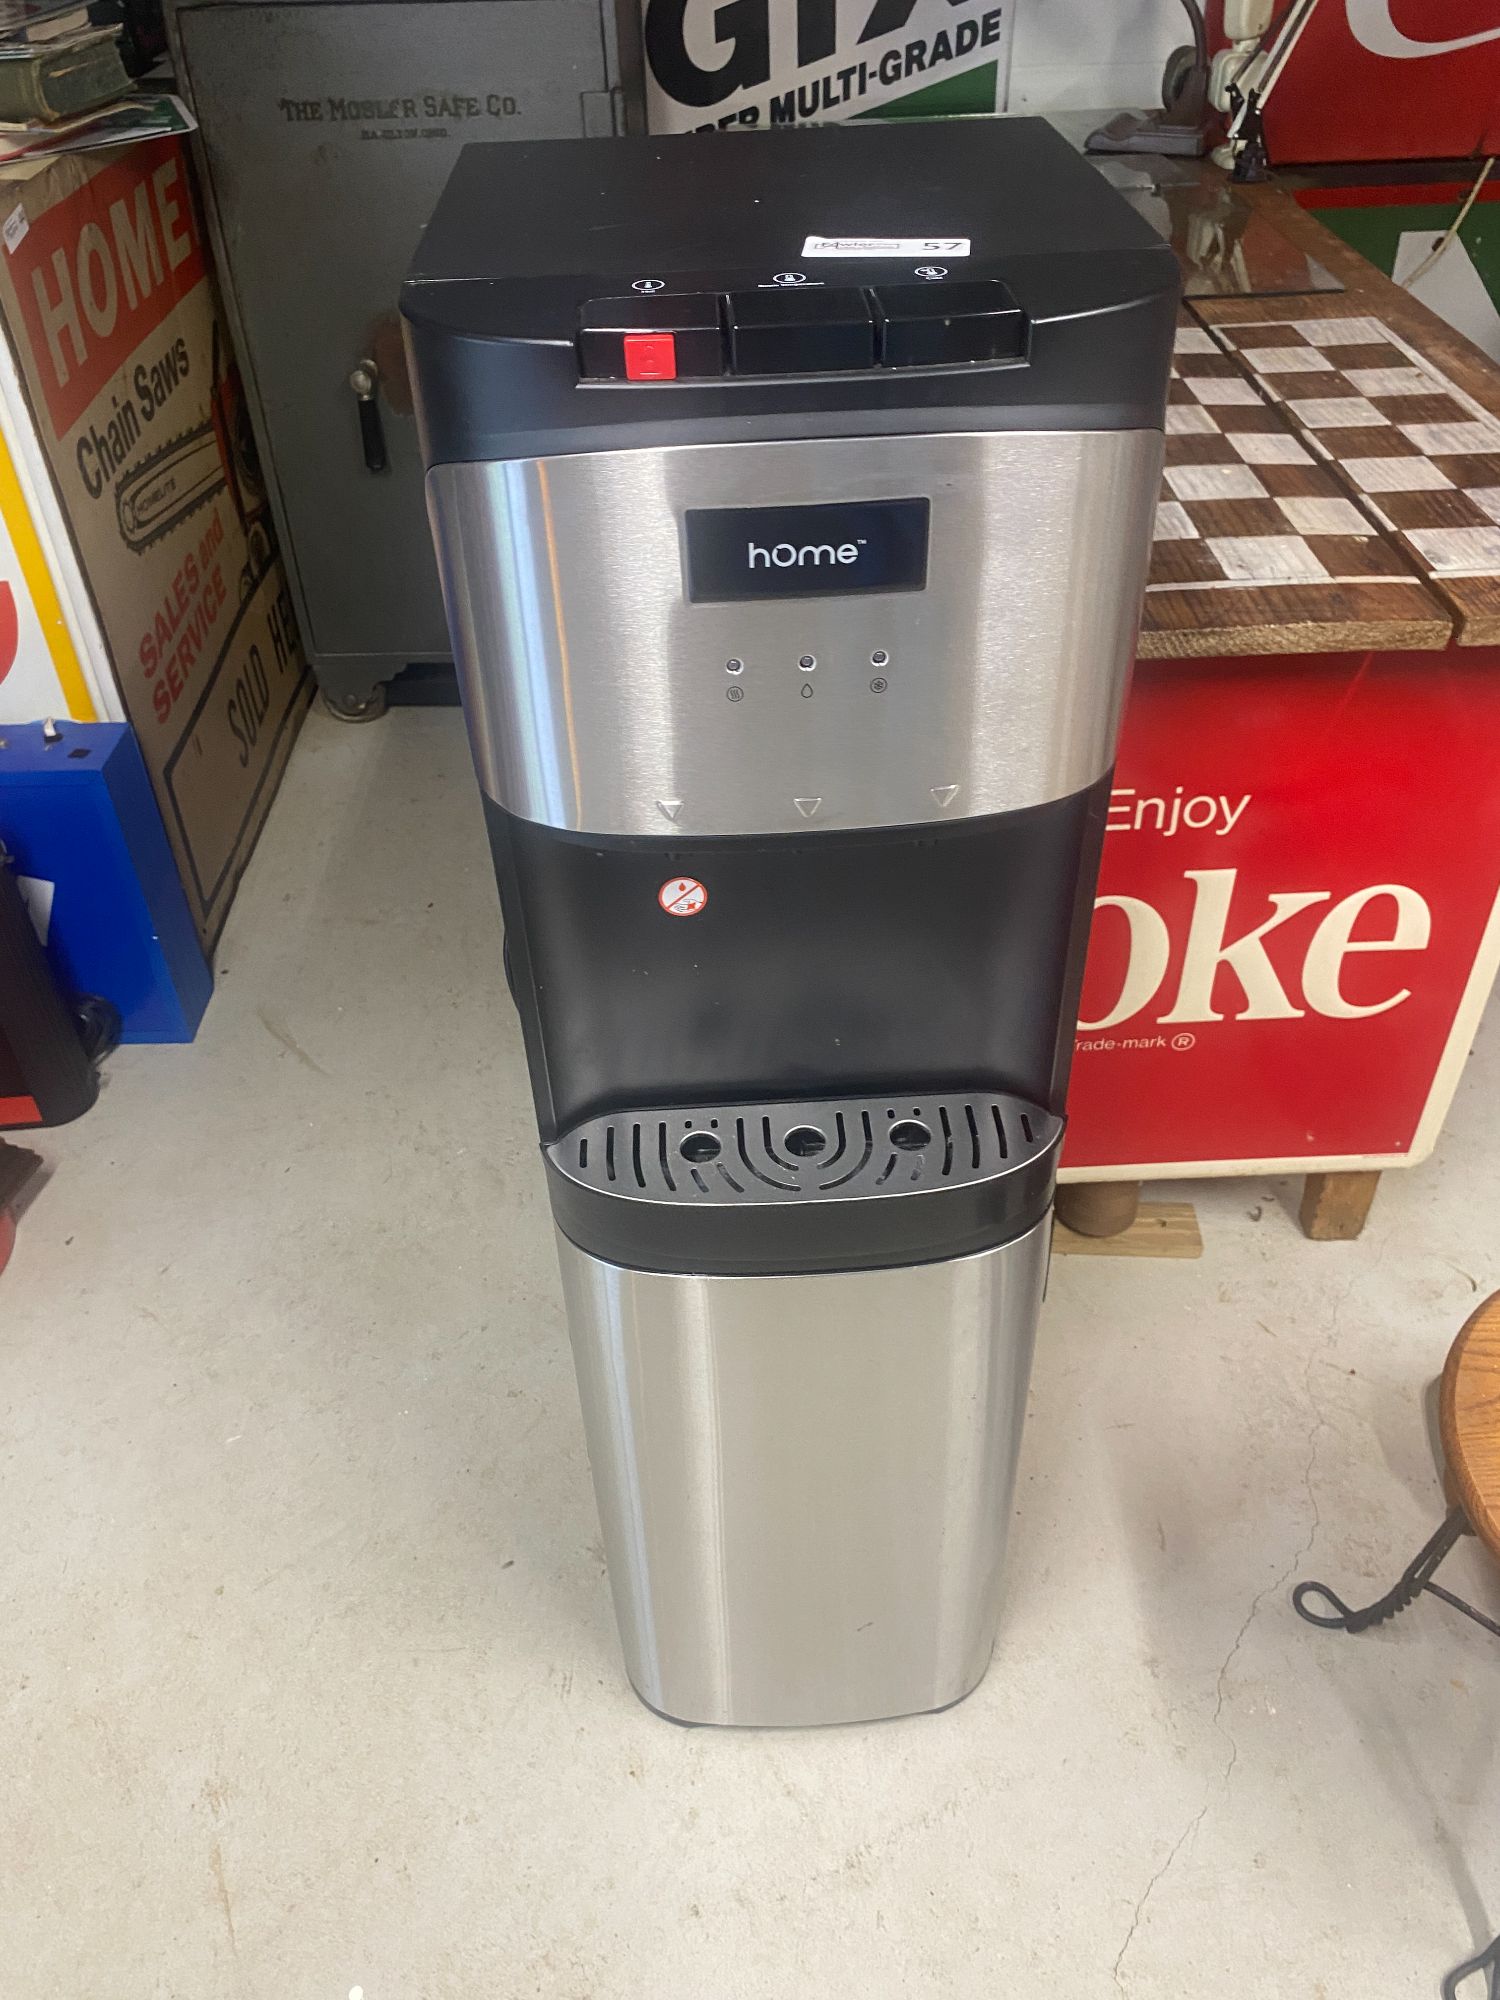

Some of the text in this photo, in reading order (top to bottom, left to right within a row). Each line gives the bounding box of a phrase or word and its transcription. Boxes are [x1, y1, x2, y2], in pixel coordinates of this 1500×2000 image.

[280, 97, 323, 122] THE
[423, 95, 480, 119] SAFE
[770, 9, 1001, 124] MULTI-GRADE
[31, 157, 192, 388] HOME
[923, 242, 962, 251] 57
[77, 338, 189, 499] Chain Saws
[748, 542, 858, 569] home
[138, 552, 199, 679] SALES
[153, 563, 227, 724] SERVICE
[227, 644, 270, 768] SOLD
[1105, 786, 1252, 836] Enjoy
[1076, 868, 1432, 1032] oke
[1075, 1035, 1167, 1051] rade-mark
